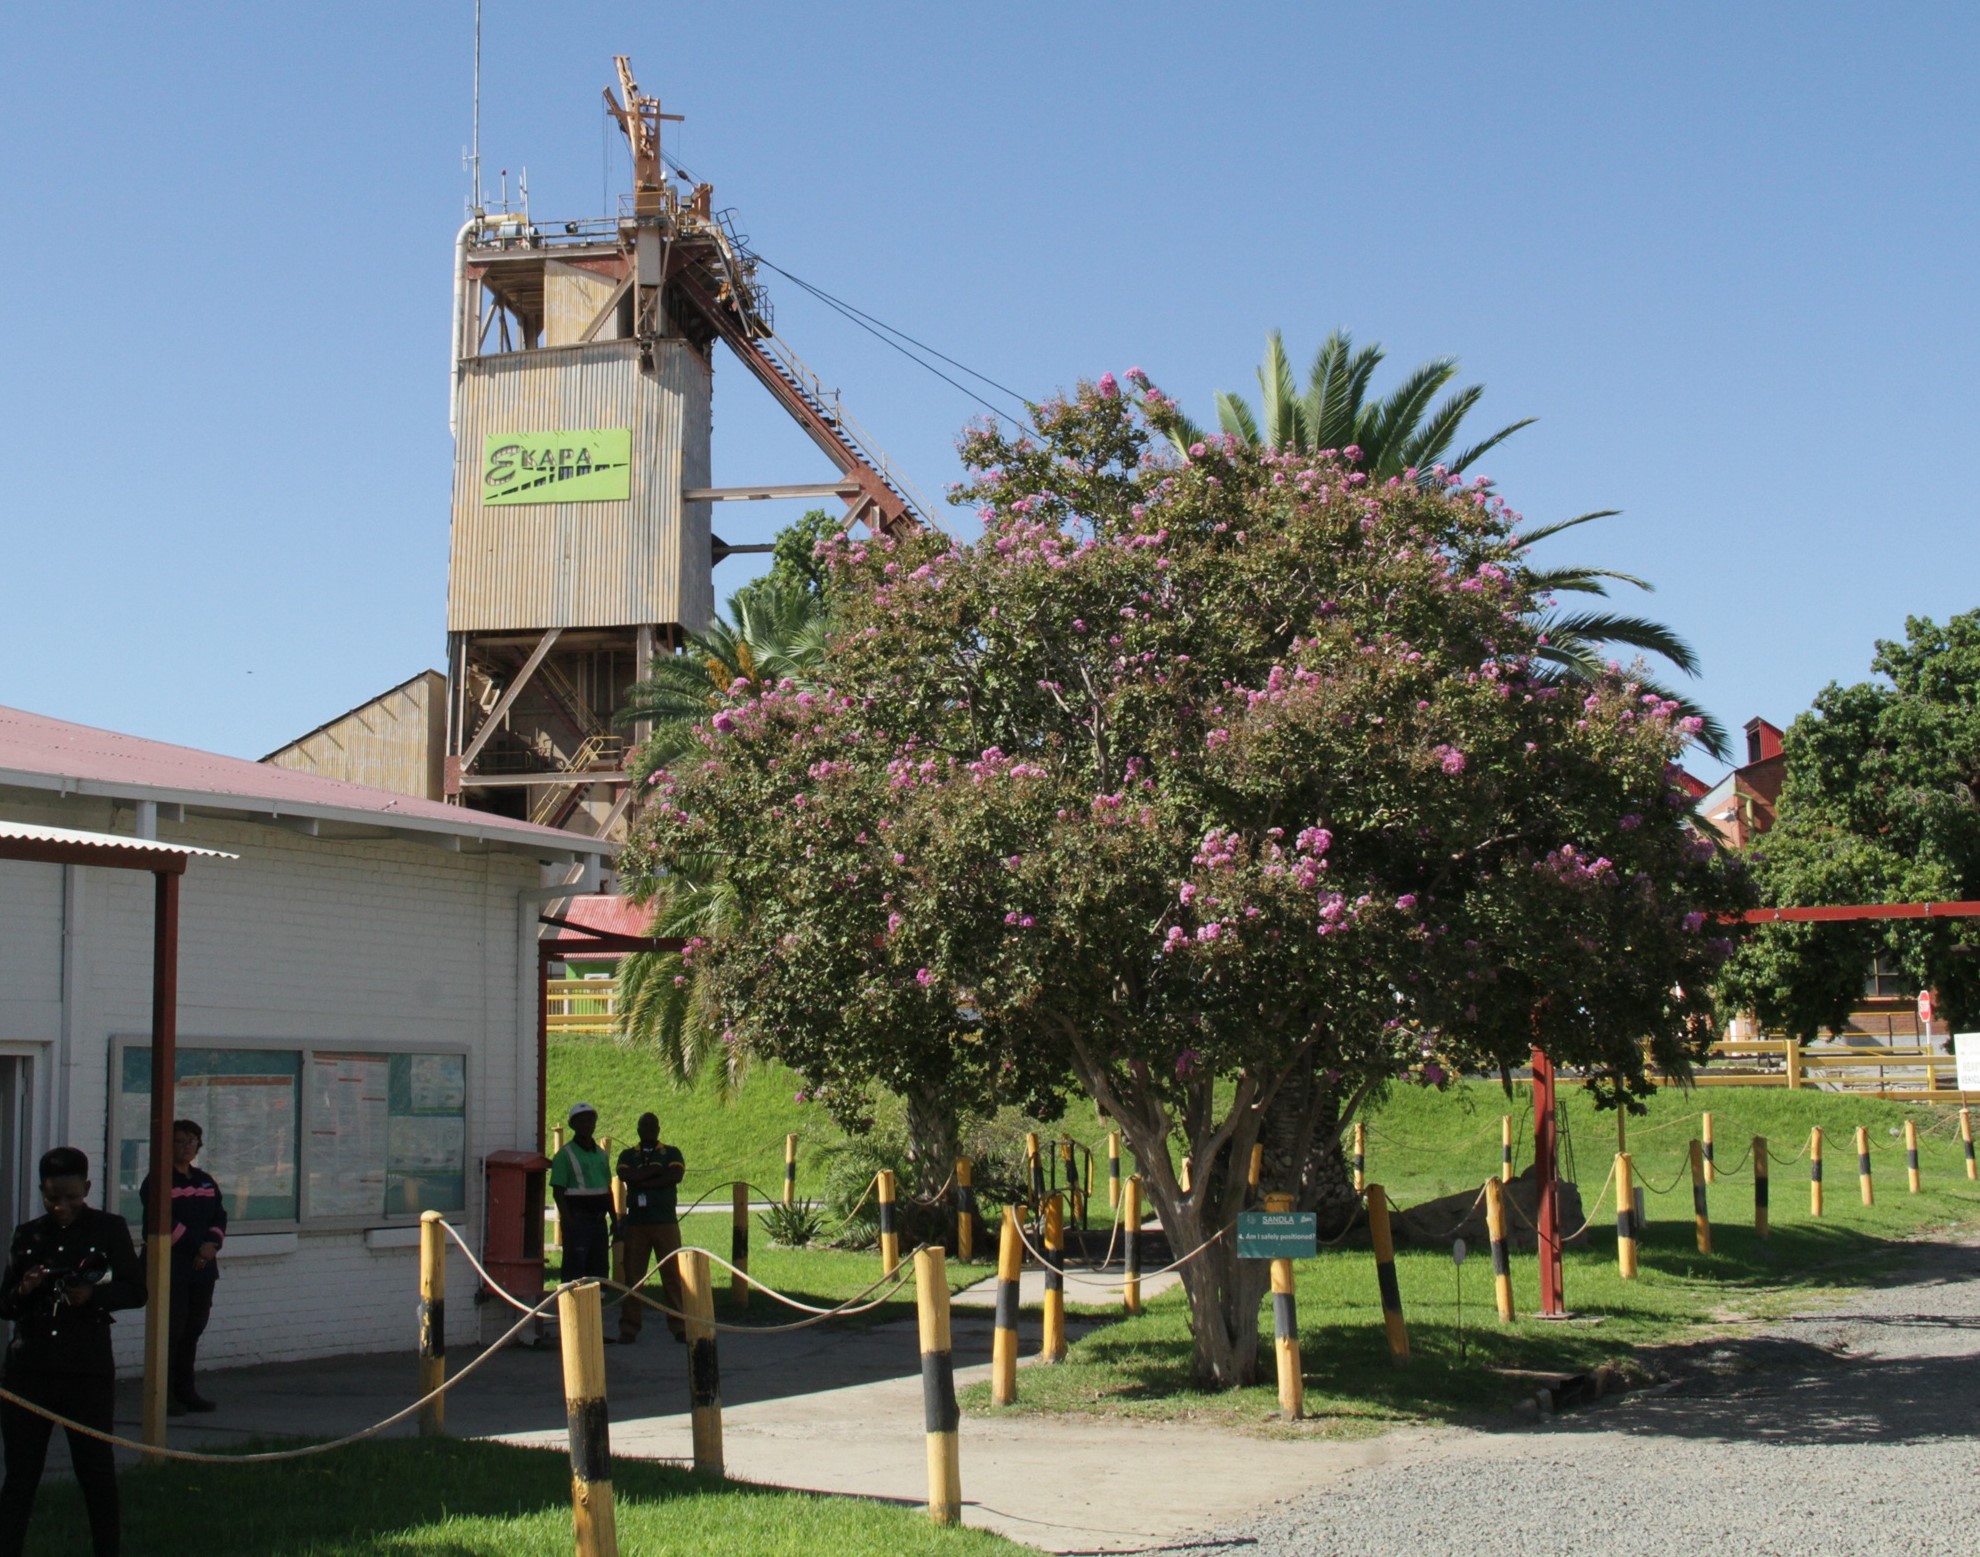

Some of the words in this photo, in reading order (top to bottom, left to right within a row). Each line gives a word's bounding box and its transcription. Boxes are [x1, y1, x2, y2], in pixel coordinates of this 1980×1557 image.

[484, 444, 592, 487] EKAPA
[1262, 1216, 1295, 1225] SANDLA
[1261, 1232, 1279, 1241] safely
[1280, 1233, 1316, 1241] positioned?
